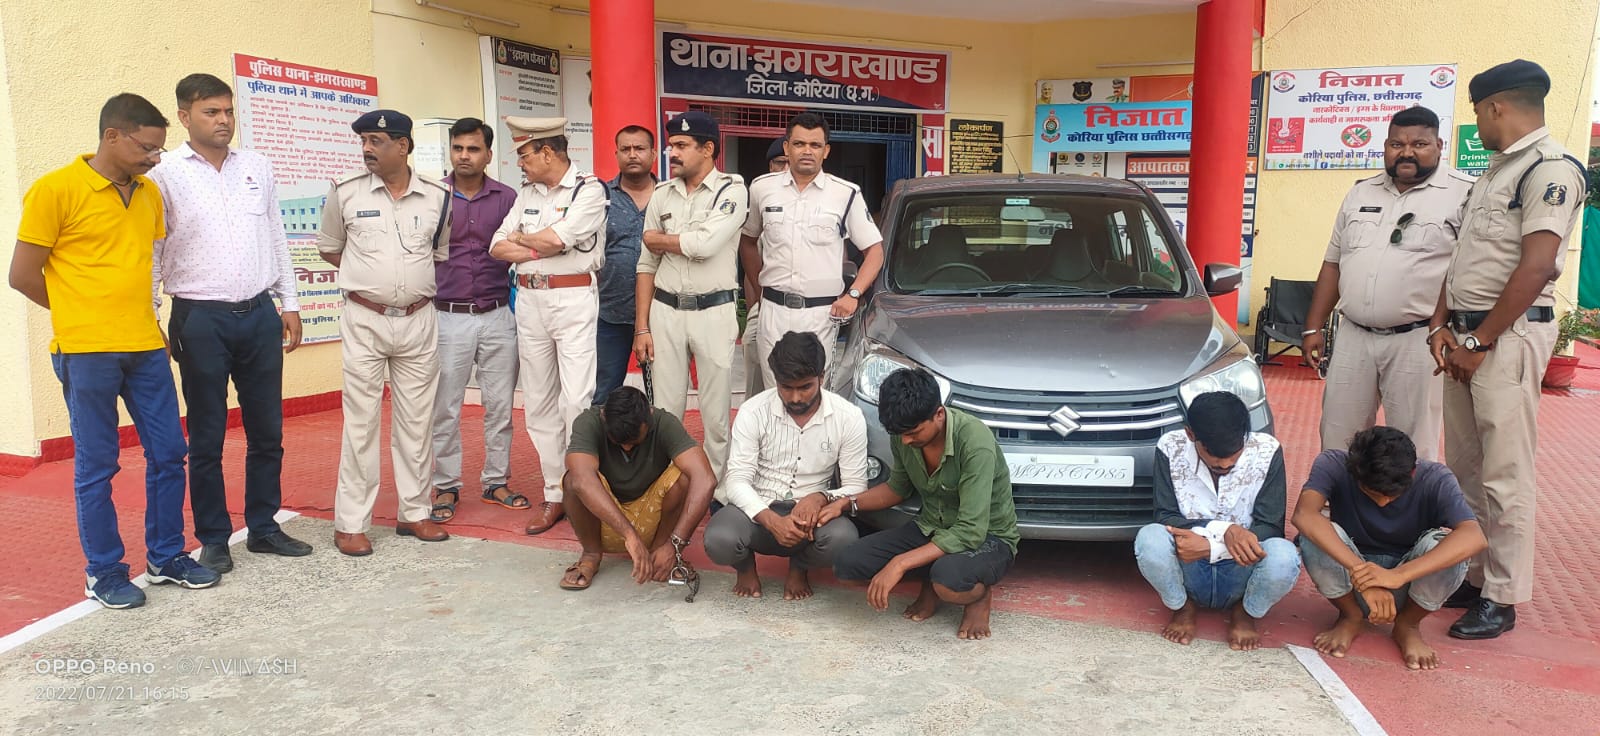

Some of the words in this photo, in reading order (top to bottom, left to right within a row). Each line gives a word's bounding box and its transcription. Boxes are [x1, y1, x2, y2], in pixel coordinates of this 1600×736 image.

[249, 60, 282, 78] पुलिस
[670, 38, 940, 84] थाना-झगराखाण्ड
[1318, 71, 1405, 89] निजात
[247, 80, 276, 94] पुलिस
[278, 85, 297, 97] थाने
[310, 90, 336, 102] आपके
[338, 93, 370, 107] अधिकार
[1298, 92, 1334, 104] कोरिया
[1337, 91, 1370, 105] पुलिस,
[1373, 90, 1423, 101] छत्तीसगढ़
[1083, 105, 1187, 128] निजात
[1067, 131, 1104, 142] कोरिया
[1106, 130, 1138, 144] पुलिस
[1128, 160, 1190, 173] आपातका
